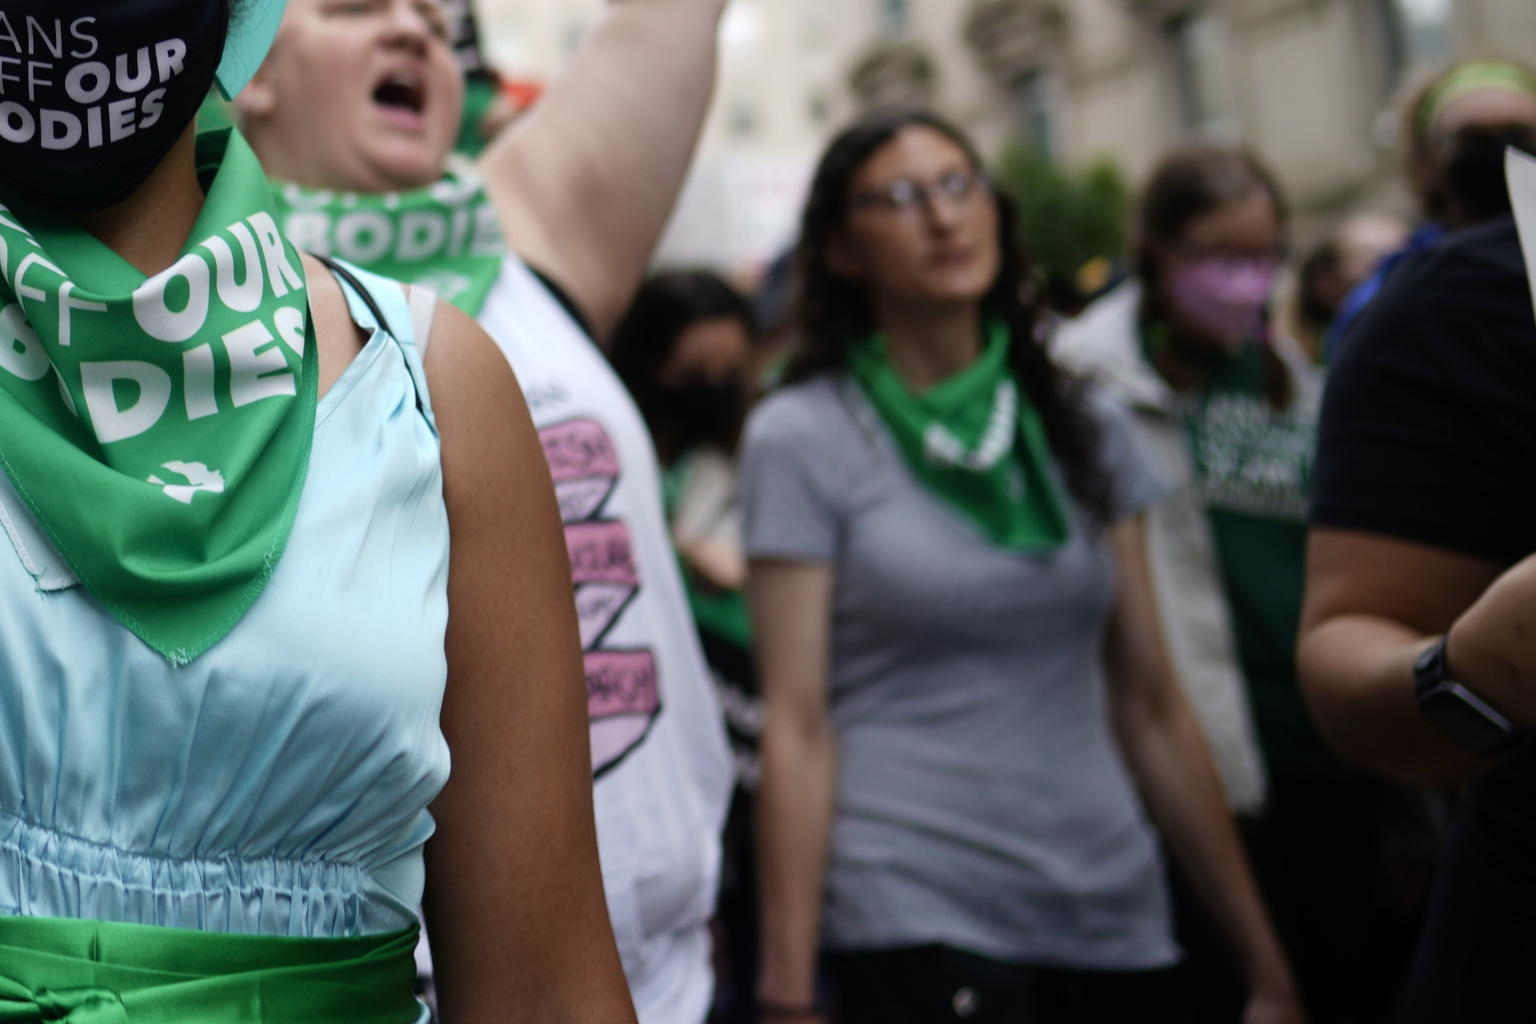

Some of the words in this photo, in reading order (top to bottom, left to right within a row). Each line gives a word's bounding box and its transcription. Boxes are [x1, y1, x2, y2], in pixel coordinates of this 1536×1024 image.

[64, 37, 187, 104] OUR
[285, 209, 505, 263] BODIE
[133, 211, 303, 343] OUR
